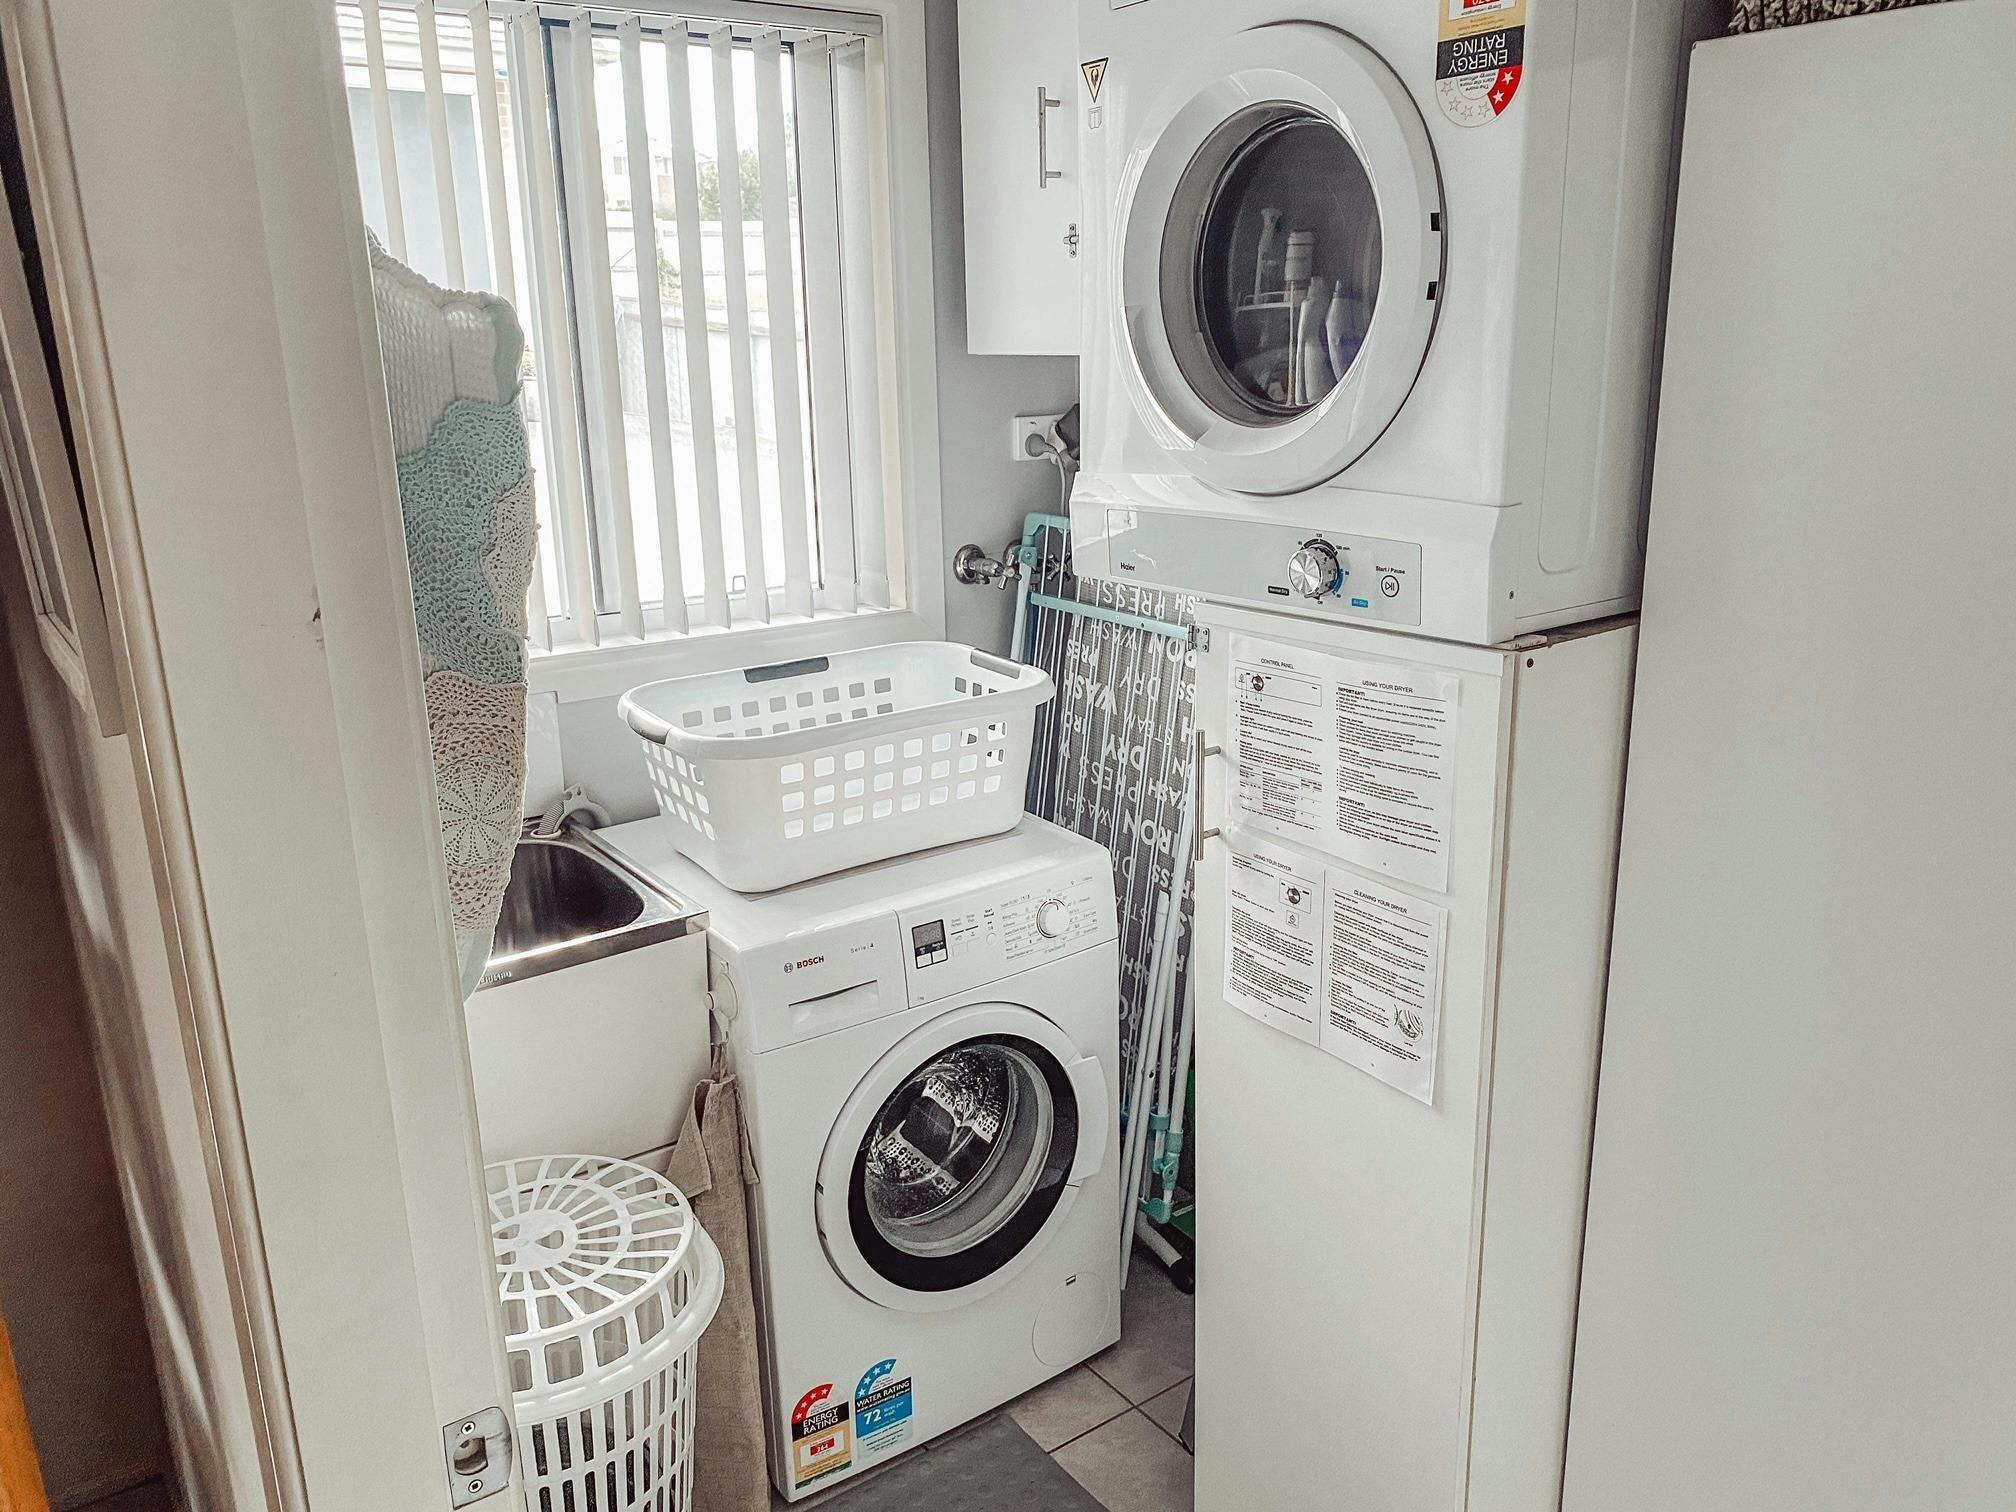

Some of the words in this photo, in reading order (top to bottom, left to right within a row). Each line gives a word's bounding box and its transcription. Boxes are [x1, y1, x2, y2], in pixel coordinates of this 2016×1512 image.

[1453, 33, 1506, 57] RATING
[1448, 49, 1508, 75] ENERGY
[1120, 562, 1136, 572] Haier
[1102, 581, 1166, 619] PRESS
[1090, 620, 1137, 651] WASH
[1067, 638, 1100, 667] PRES
[1260, 657, 1280, 668] CONTROL
[1280, 662, 1294, 670] PANEL
[1063, 668, 1119, 716] WASH
[1119, 666, 1162, 702] DRY
[1362, 679, 1378, 688] USING
[1378, 683, 1393, 691] YOUR
[1061, 707, 1088, 736] IRO
[1123, 709, 1173, 746] STEAM
[1104, 733, 1146, 772] DRY
[1079, 757, 1141, 803] PRESS
[1065, 789, 1113, 828] WASH
[1339, 795, 1366, 808] IMPORTANT!
[1253, 853, 1266, 862] USING
[1265, 857, 1277, 866] YOUR
[1277, 862, 1292, 872] DRYER
[1114, 894, 1148, 925] STEA
[1353, 889, 1376, 903] CLEANING
[1376, 898, 1390, 908] YOUR
[1390, 903, 1408, 914] DRYER
[796, 955, 825, 969] BOSCH
[850, 944, 867, 954] Serie
[856, 1392, 882, 1408] WATER
[883, 1380, 910, 1396] RATING
[803, 1407, 838, 1428] ENERGY
[803, 1415, 839, 1435] RATING
[864, 1408, 882, 1425] 72
